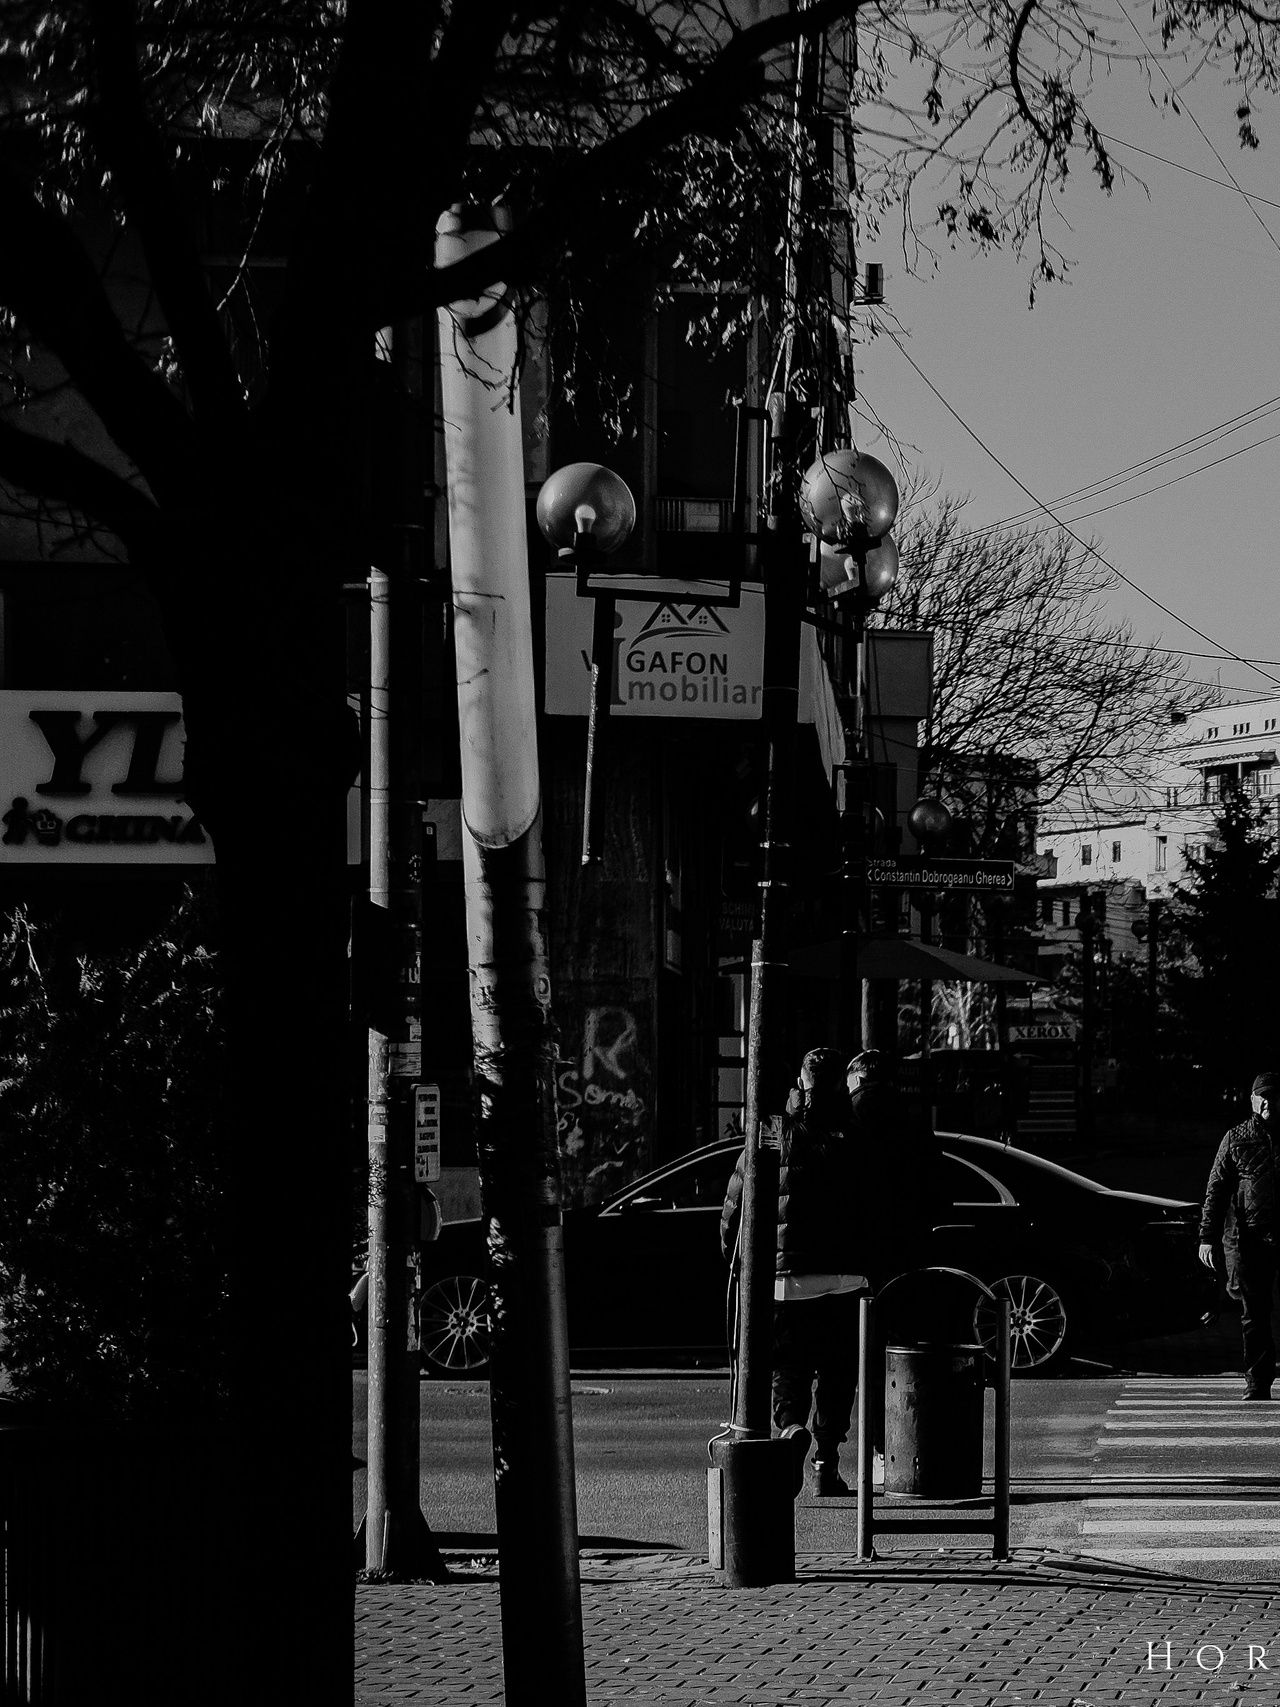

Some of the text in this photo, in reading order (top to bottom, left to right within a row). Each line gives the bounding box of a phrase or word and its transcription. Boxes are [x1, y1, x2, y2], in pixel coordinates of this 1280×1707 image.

[873, 868, 1006, 888] Constantin Dobrogeanu Gherea
[1015, 1025, 1071, 1038] XEROX
